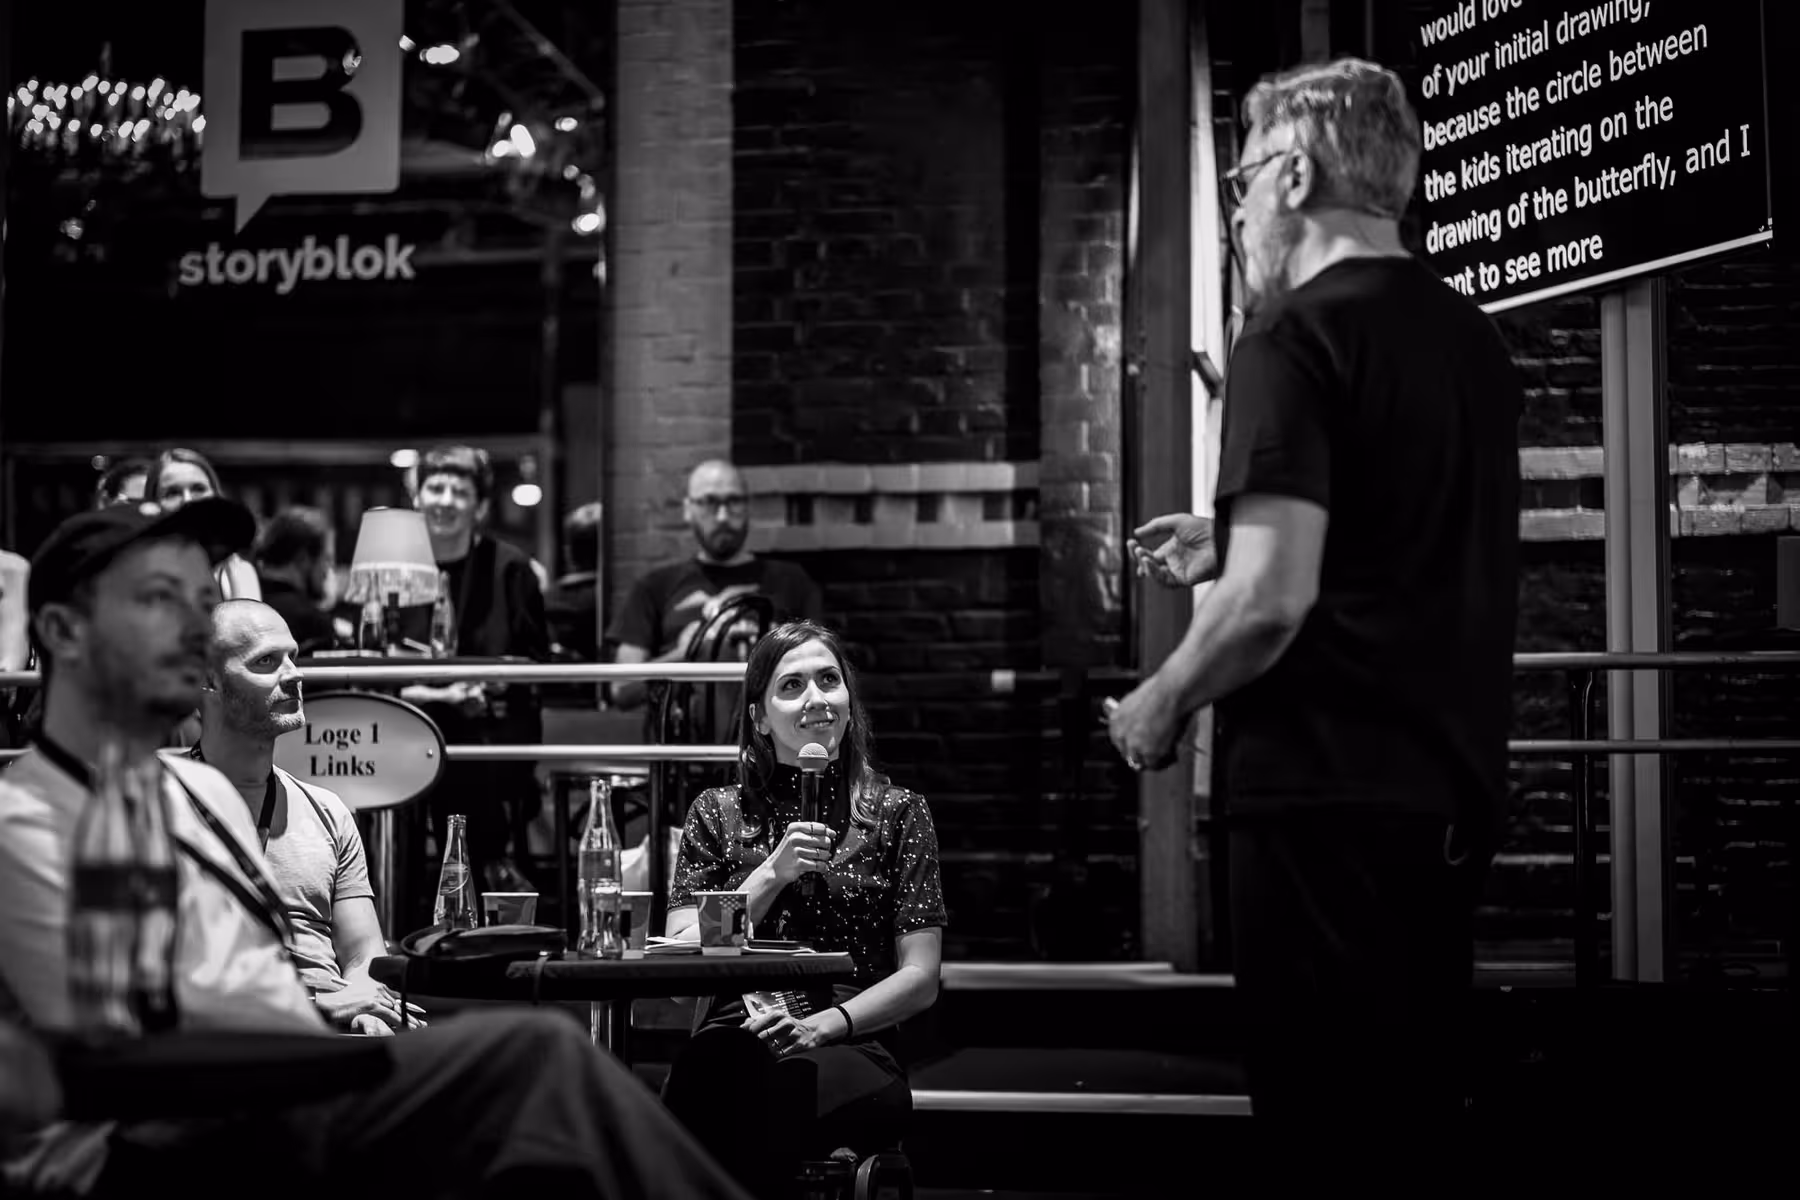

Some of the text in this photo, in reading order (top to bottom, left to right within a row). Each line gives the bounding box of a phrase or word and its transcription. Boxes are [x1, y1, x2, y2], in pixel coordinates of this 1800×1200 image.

[1420, 0, 1476, 48] would
[1422, 0, 1651, 99] of your initial drawing,
[239, 25, 364, 161] B
[1423, 23, 1708, 152] because the circle between
[1423, 95, 1674, 203] the kids iterating on the
[1425, 124, 1752, 255] drawing of the butterfly, and I
[178, 234, 417, 295] storyblok
[1478, 261, 1501, 292] to
[1504, 251, 1542, 285] see
[1546, 234, 1604, 273] more
[303, 721, 380, 750] Loge 1
[309, 755, 376, 777] Links
